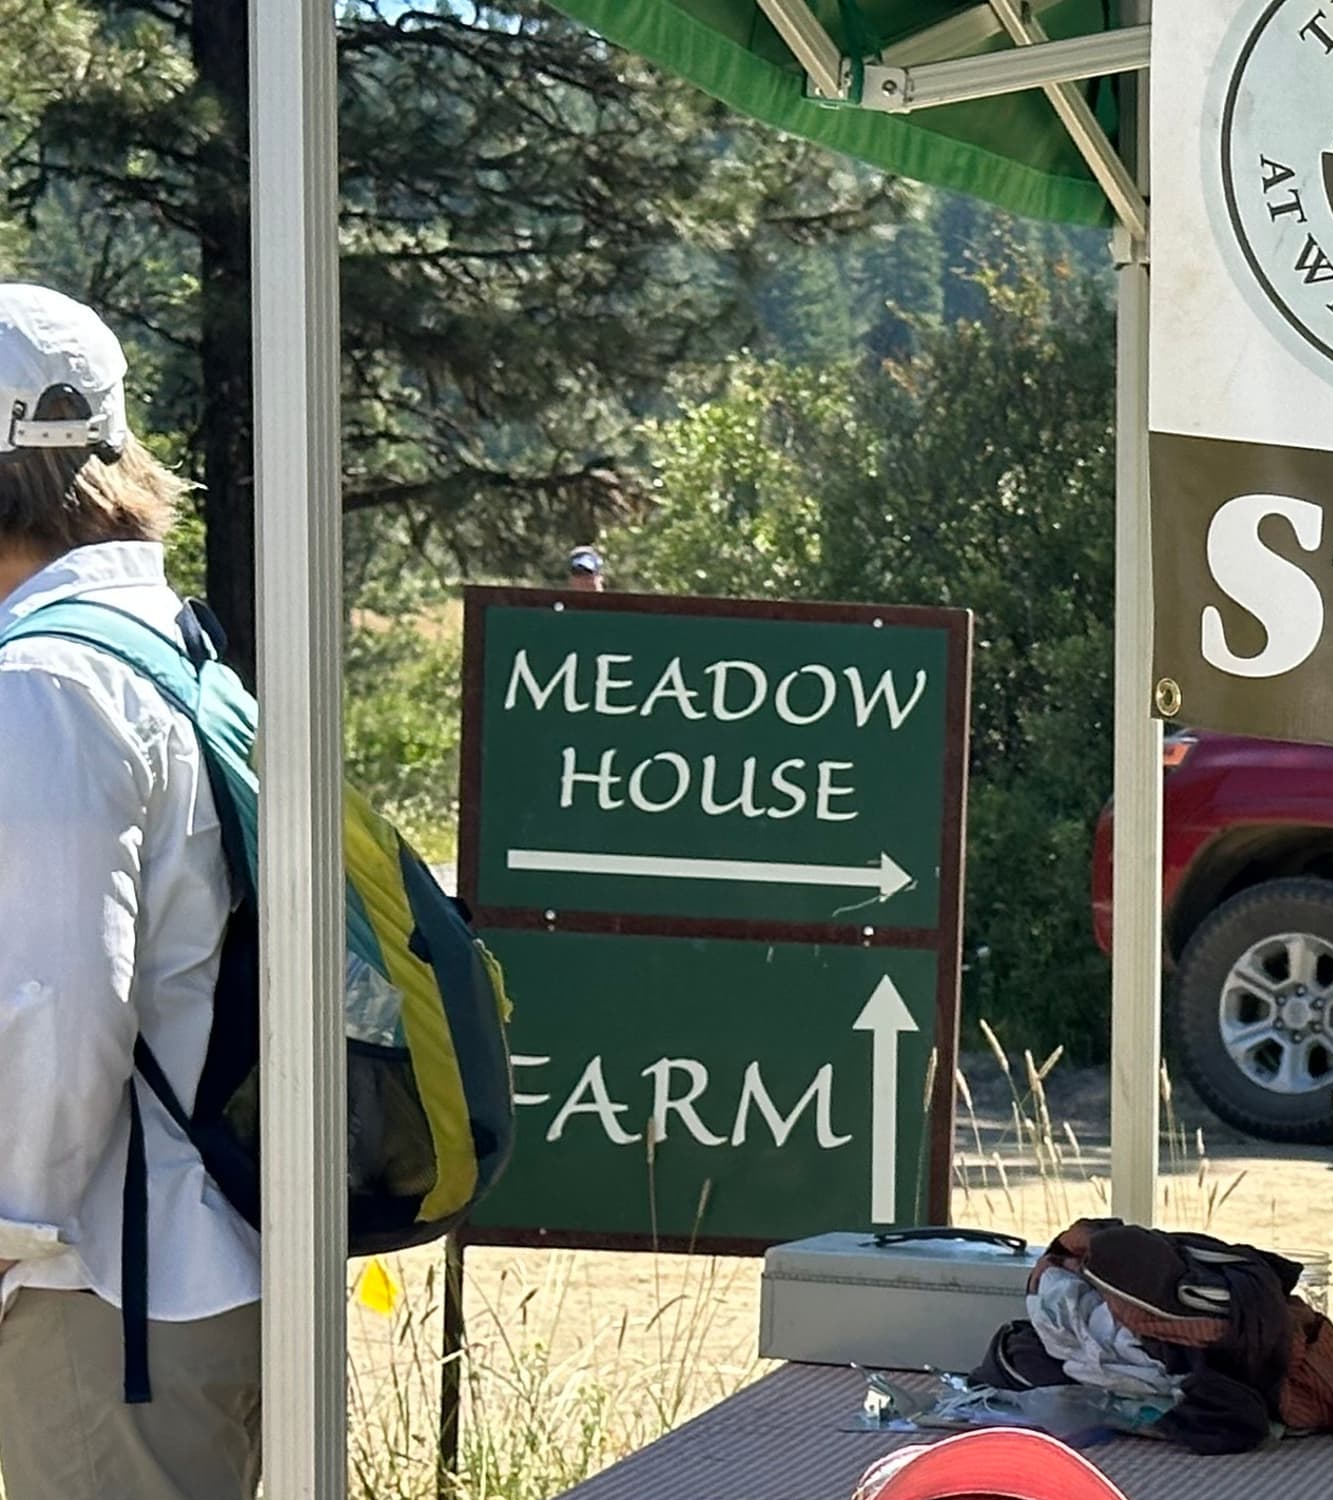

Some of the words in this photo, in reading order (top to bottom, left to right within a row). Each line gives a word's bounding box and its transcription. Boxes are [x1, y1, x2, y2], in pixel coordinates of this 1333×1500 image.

[1259, 153, 1307, 224] AT
[504, 649, 927, 730] MEADOW
[560, 747, 859, 821] HOUSE
